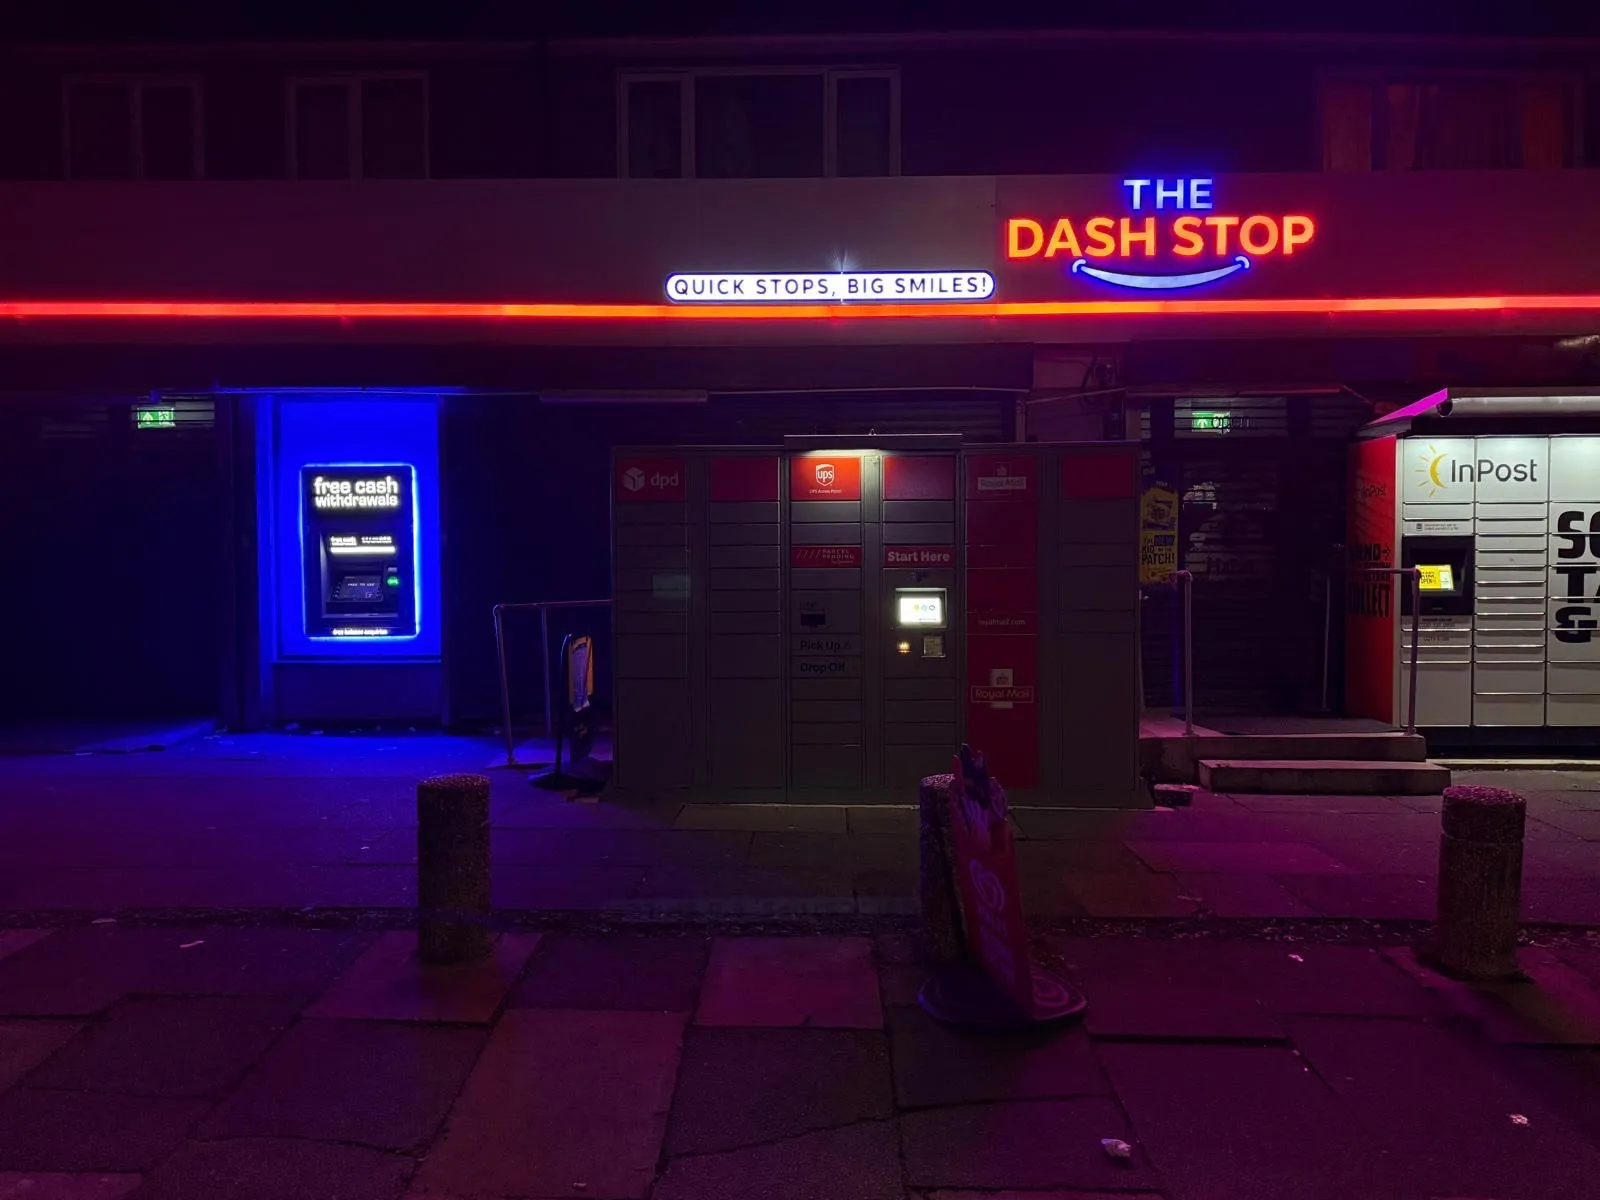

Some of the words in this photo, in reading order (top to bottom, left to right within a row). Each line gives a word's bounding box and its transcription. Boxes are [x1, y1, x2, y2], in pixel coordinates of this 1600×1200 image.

[1123, 178, 1214, 211] THE
[1007, 217, 1156, 258] DASH
[1172, 214, 1315, 256] STOP
[674, 276, 744, 296] QUICK
[755, 276, 836, 297] STOPS,
[848, 275, 884, 294] BIG
[894, 275, 988, 295] SMILES!
[816, 469, 833, 482] ups
[1452, 459, 1538, 482] InPost
[313, 476, 351, 494] free
[355, 476, 399, 494] cash
[650, 470, 679, 489] dpd
[314, 494, 399, 508] withdrawals
[887, 551, 917, 562] Start
[921, 551, 951, 562] Here
[1141, 553, 1175, 565] PATCH!
[800, 640, 824, 651] Pick
[825, 640, 841, 653] Up
[800, 662, 827, 674] Drop
[828, 661, 846, 672] Off
[975, 688, 1004, 700] Royal
[1006, 688, 1031, 699] Mail
